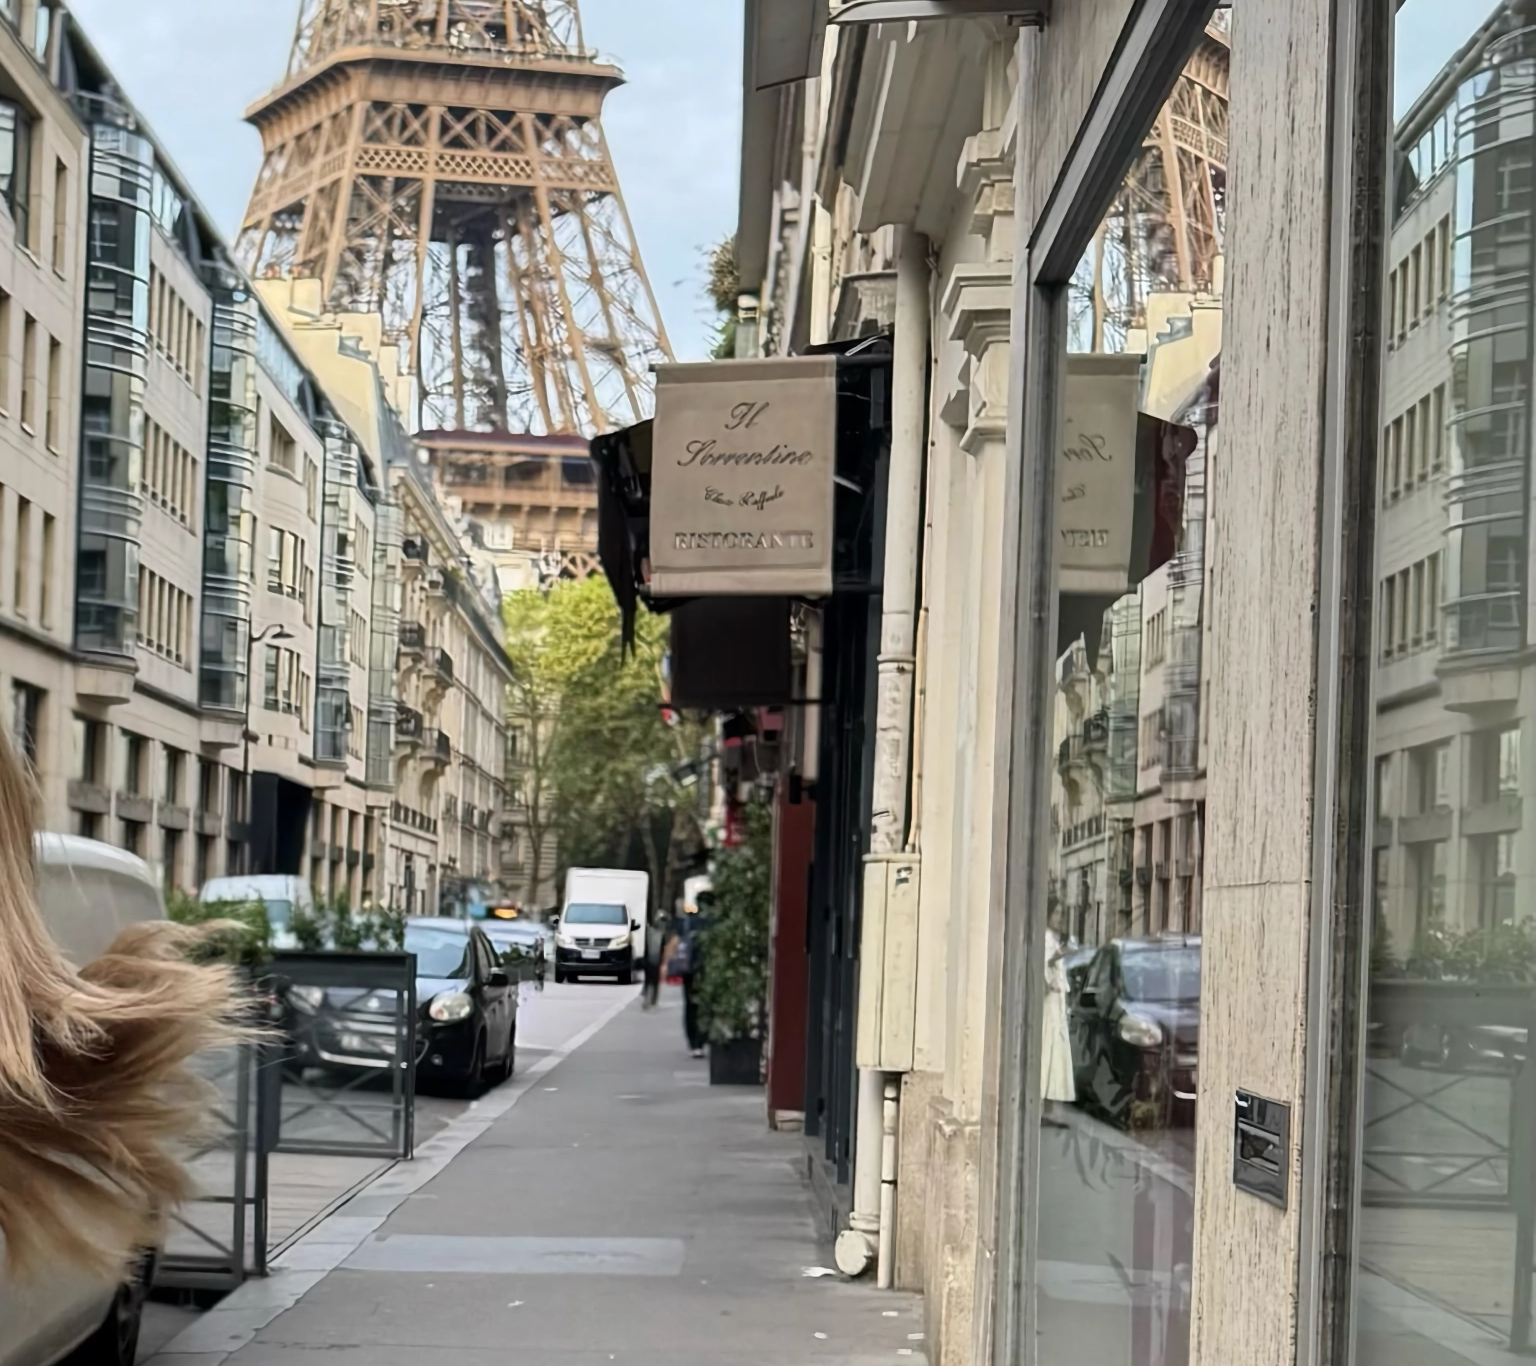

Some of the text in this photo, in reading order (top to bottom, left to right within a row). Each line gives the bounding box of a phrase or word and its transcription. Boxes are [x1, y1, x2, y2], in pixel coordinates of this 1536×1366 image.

[724, 401, 770, 430] Il
[677, 439, 814, 467] Sorrentino
[673, 531, 814, 551] RISTORANTE
